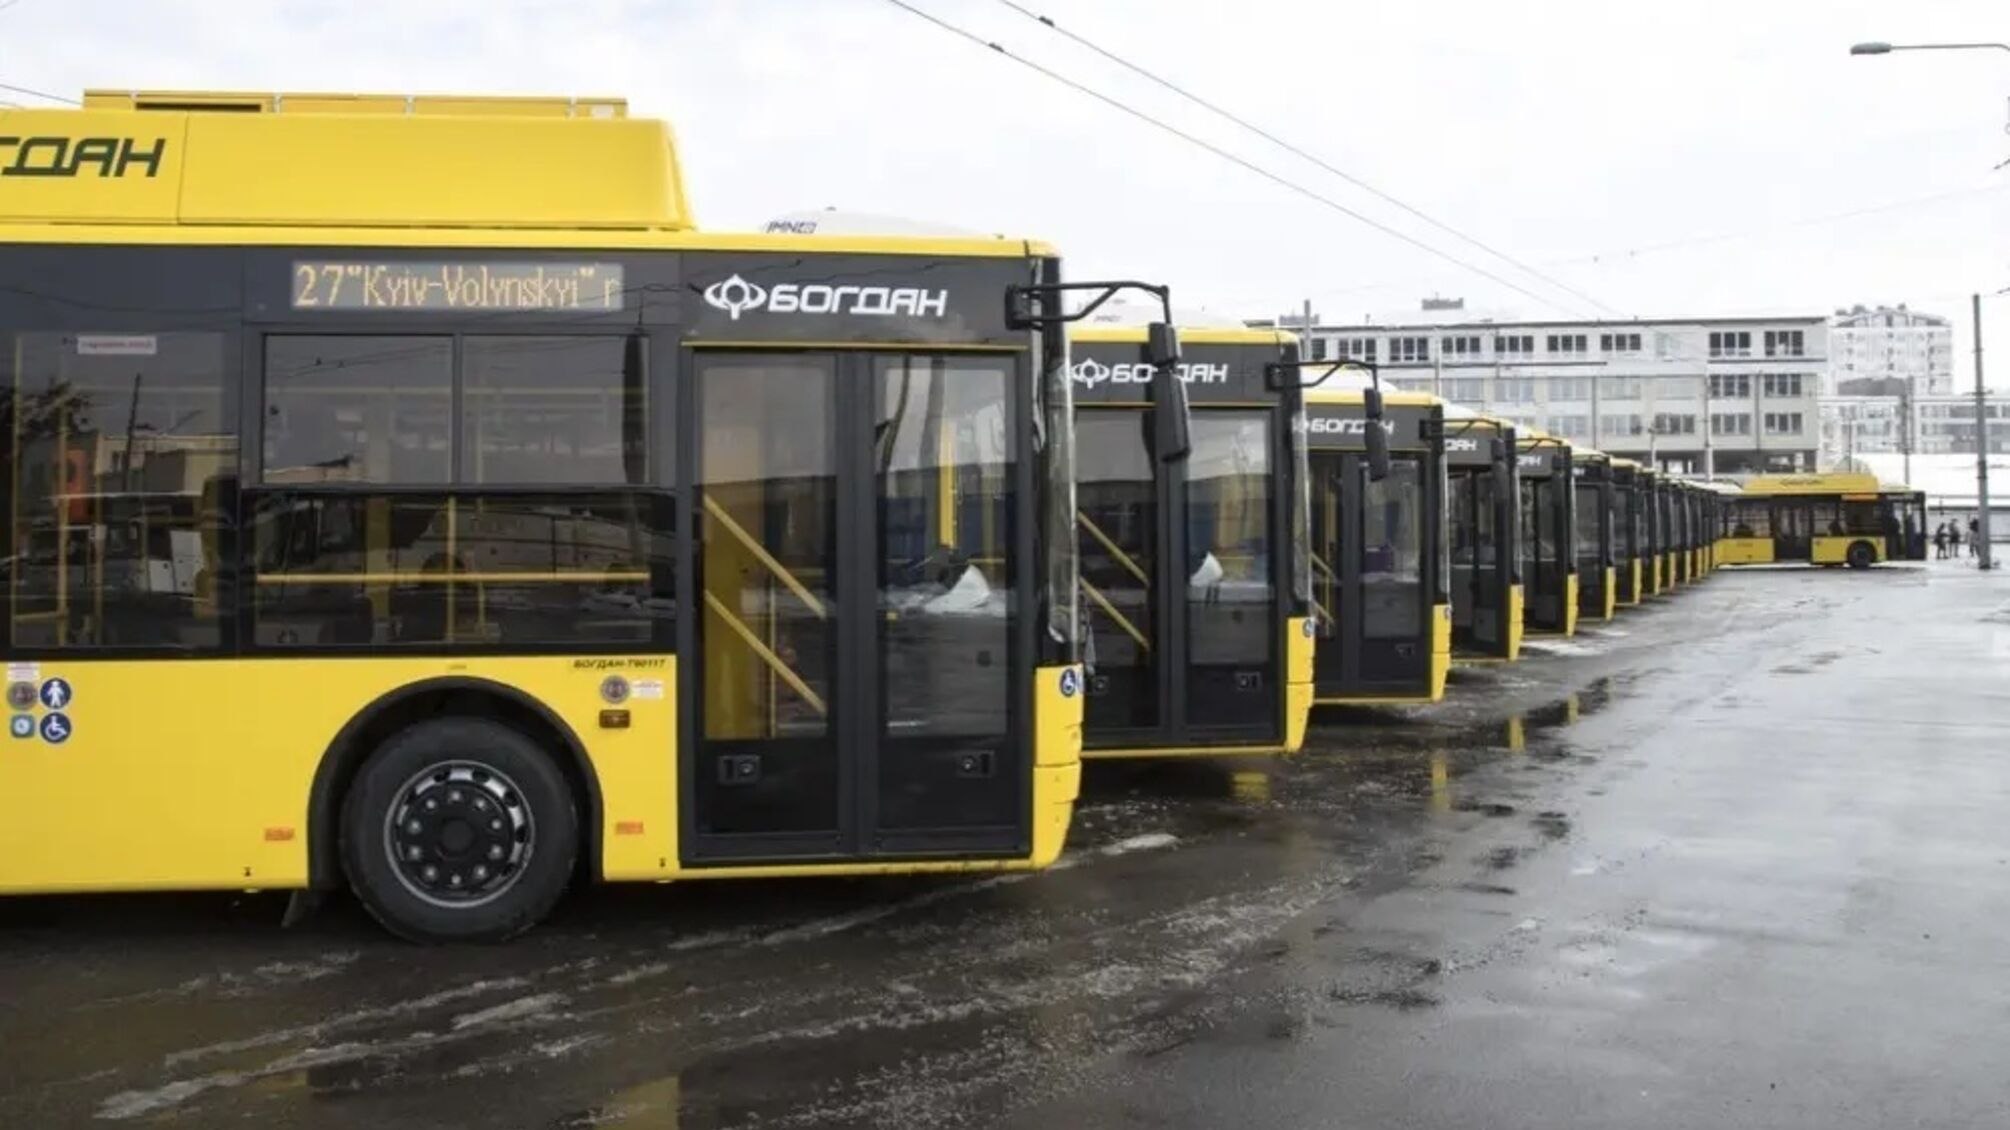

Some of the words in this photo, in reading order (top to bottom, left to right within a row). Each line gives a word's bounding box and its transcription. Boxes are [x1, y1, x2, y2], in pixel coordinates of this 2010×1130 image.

[767, 284, 948, 317] БОГДАН
[1111, 363, 1229, 383] БОДАН
[1310, 418, 1395, 435] БОГДН
